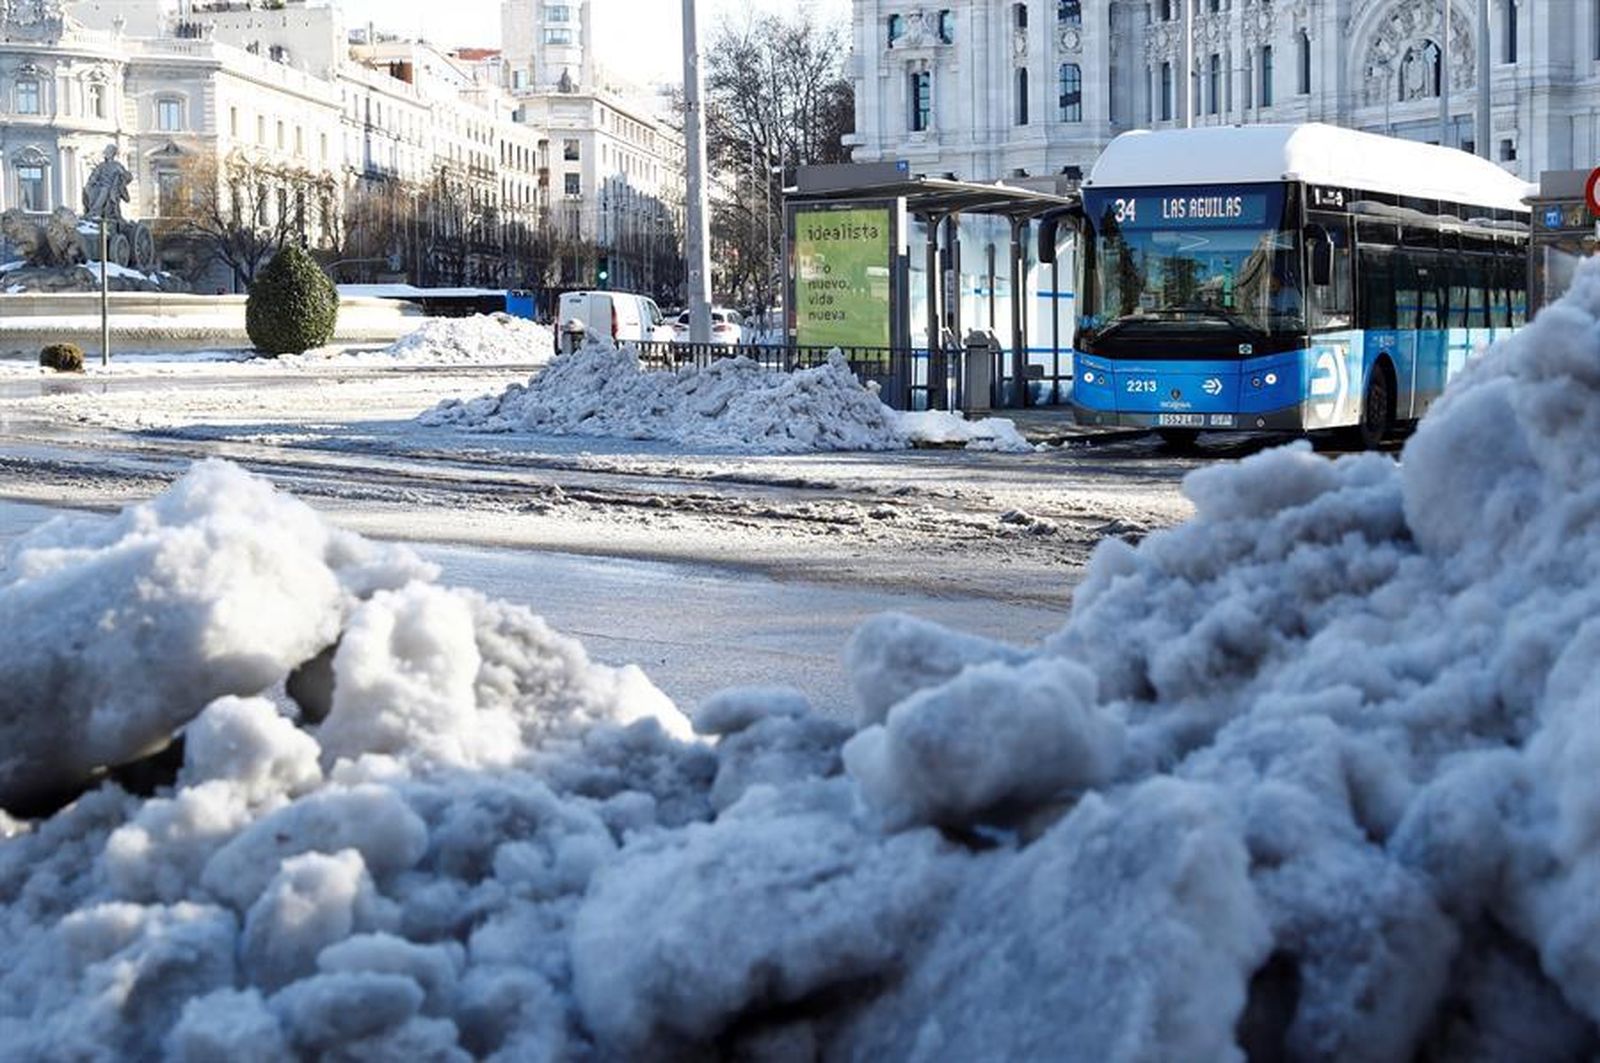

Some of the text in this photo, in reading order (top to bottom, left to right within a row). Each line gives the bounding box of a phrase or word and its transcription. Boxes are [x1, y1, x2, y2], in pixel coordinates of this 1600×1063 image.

[1114, 198, 1136, 222] 34
[1163, 197, 1242, 219] LAS AGUILAS
[808, 223, 879, 241] idealista
[808, 293, 834, 305] vida
[808, 310, 845, 321] nueva
[1126, 379, 1157, 392] 2213
